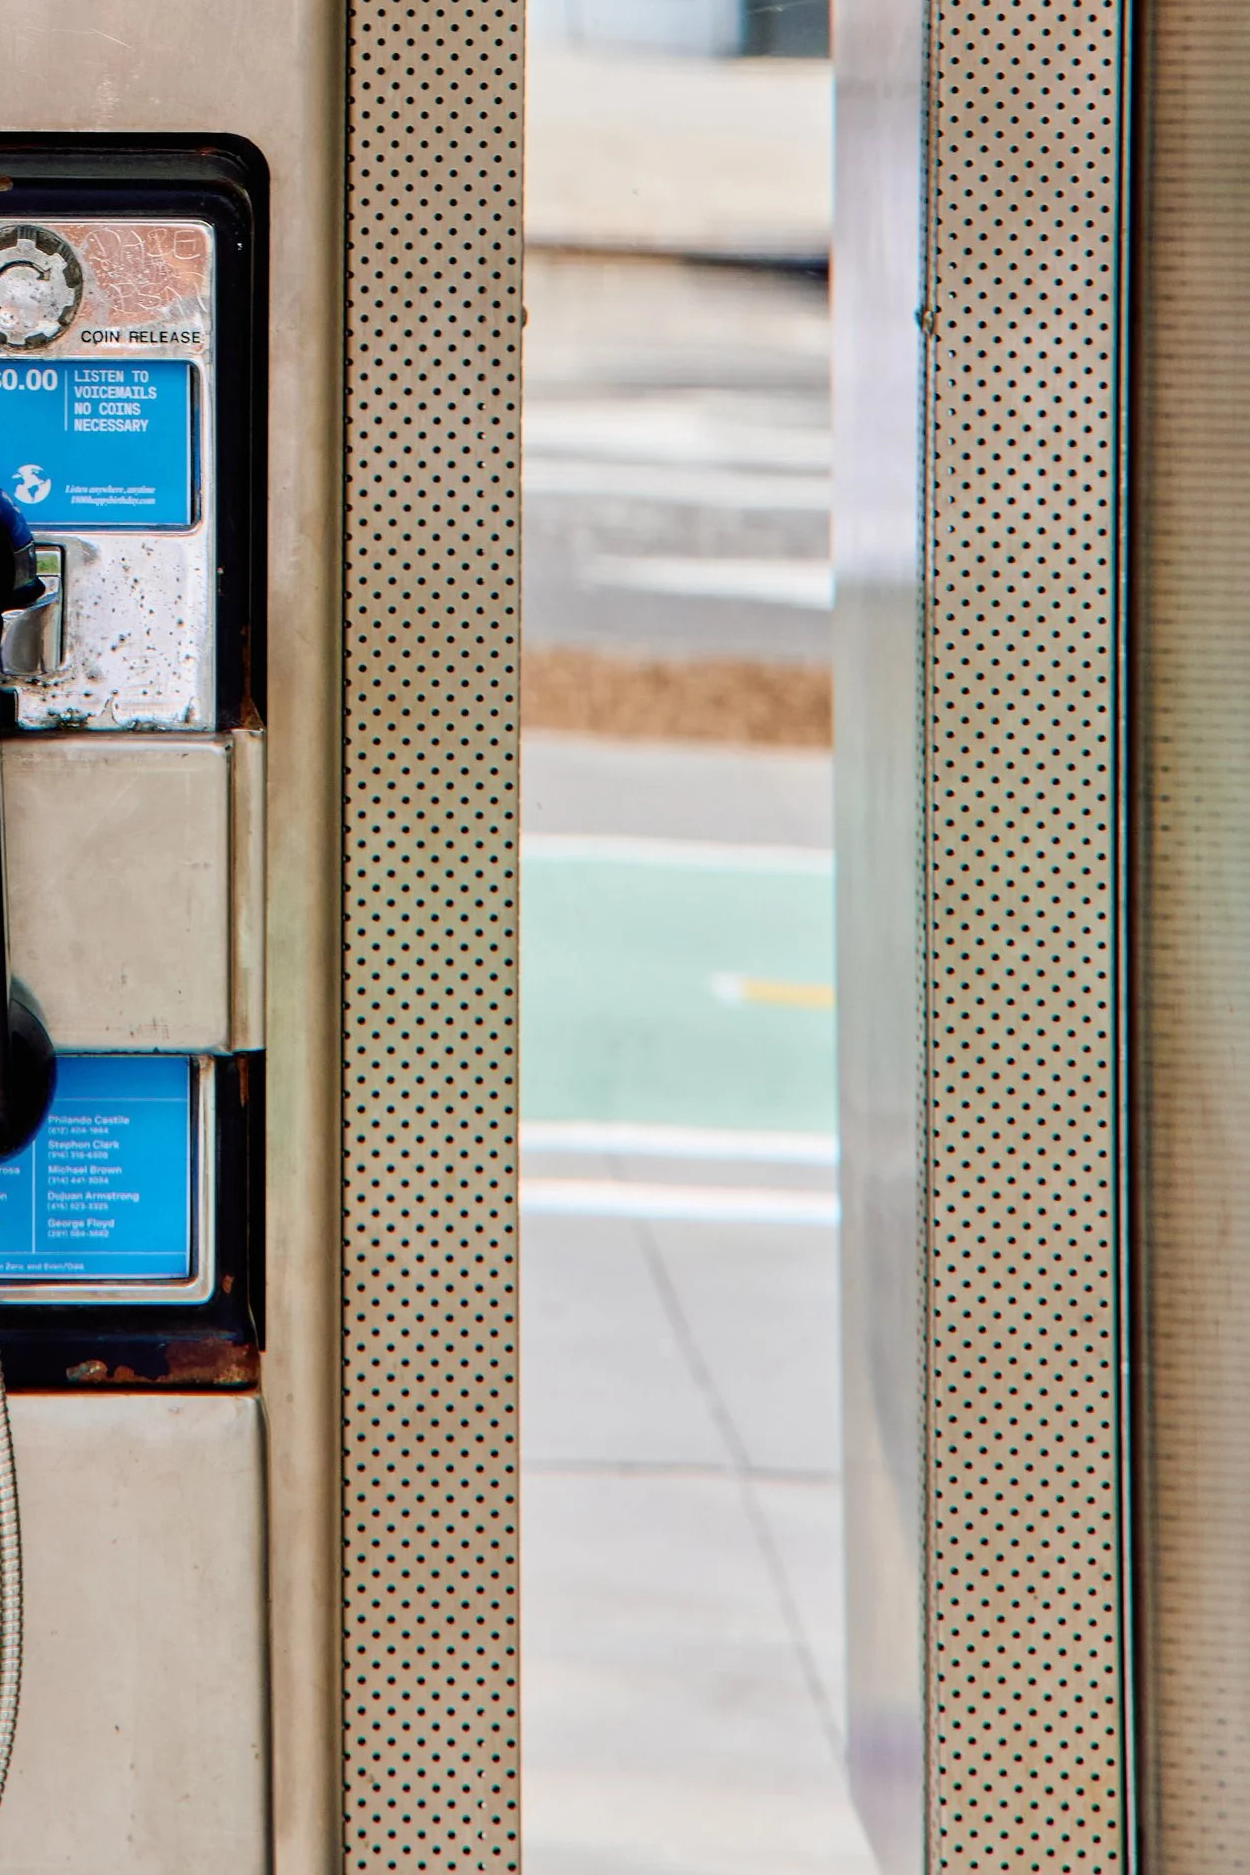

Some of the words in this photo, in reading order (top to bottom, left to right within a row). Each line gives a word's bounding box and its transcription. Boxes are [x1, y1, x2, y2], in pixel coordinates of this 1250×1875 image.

[81, 330, 119, 344] COIN
[129, 331, 201, 343] RELEASE
[74, 370, 124, 383] LISTEN
[132, 370, 149, 383] TO
[74, 386, 157, 400] VOICEMAILS
[74, 402, 91, 415] NO
[99, 402, 141, 415] COINS
[74, 419, 149, 432] NECESSARY
[93, 1140, 119, 1149] Clark
[48, 1165, 87, 1174] Michael
[90, 1165, 122, 1174] Brown
[48, 1218, 84, 1229] George
[87, 1218, 115, 1228] Floyd
